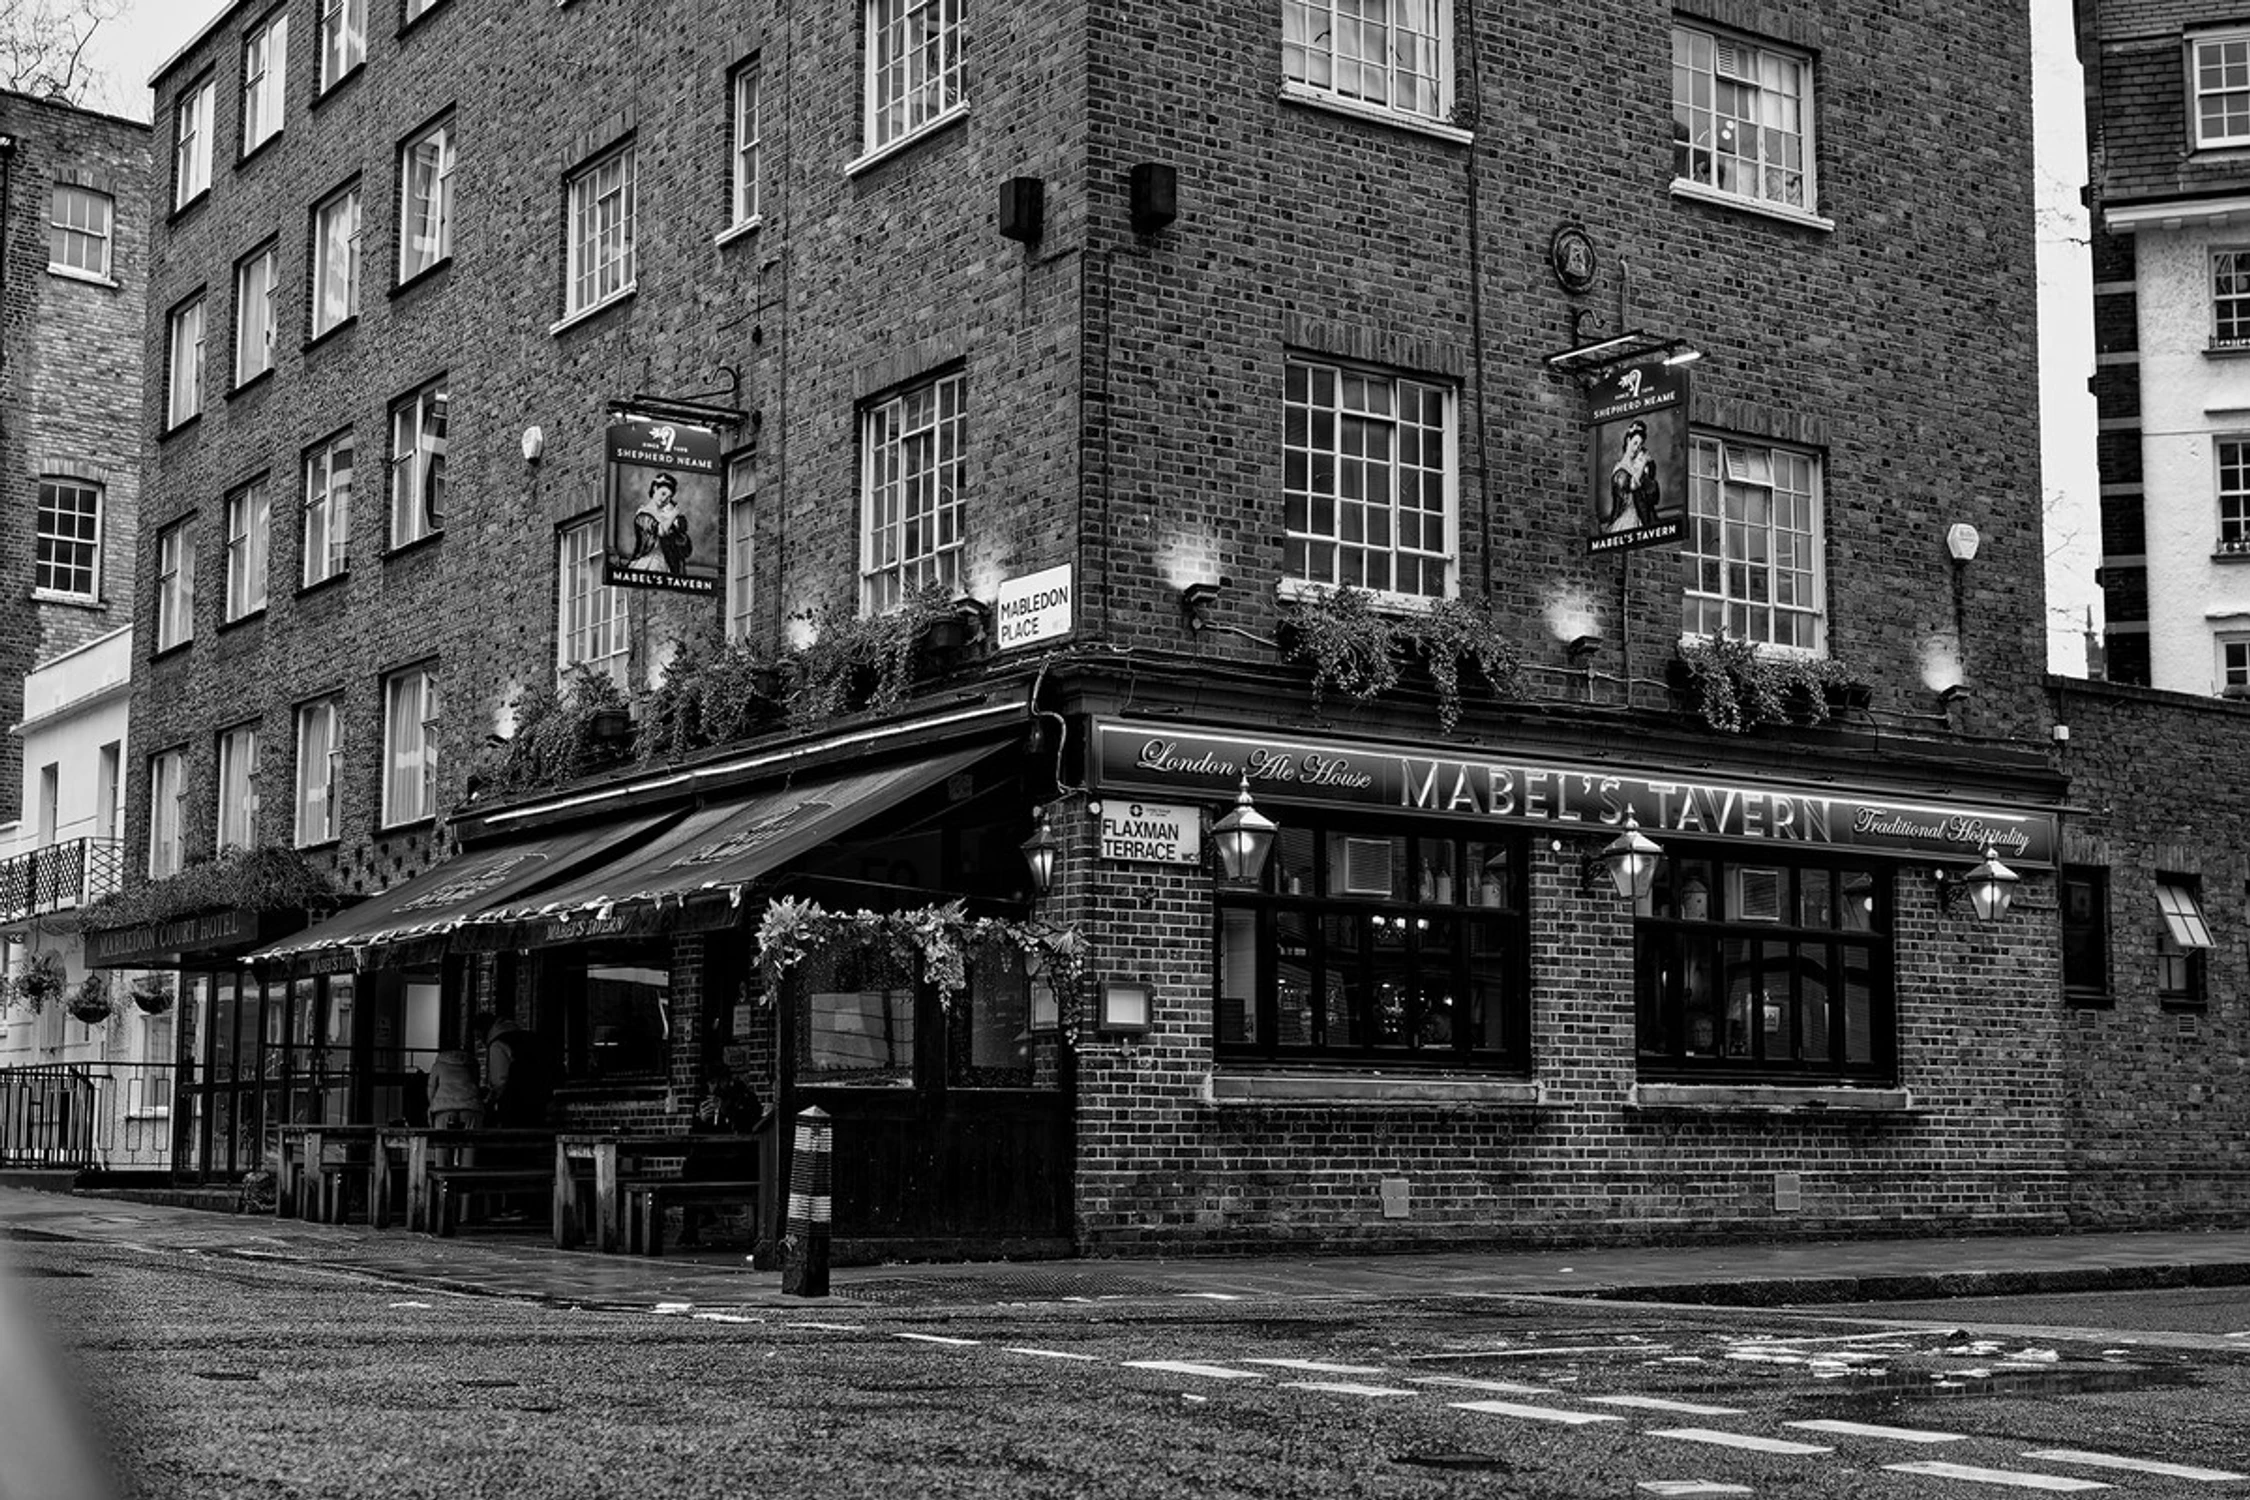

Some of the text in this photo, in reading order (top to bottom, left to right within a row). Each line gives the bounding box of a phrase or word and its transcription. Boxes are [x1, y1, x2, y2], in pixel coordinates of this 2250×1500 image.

[1593, 399, 1642, 420] SHEPHERD
[1644, 390, 1676, 407] NEAME
[617, 447, 674, 465] SHEPHERD
[677, 456, 713, 470] NEAME
[1591, 524, 1676, 551] MABEL'S TAVERN
[612, 571, 713, 591] MABEL'S TAVERN
[1001, 585, 1068, 620] MABLEDON
[1002, 617, 1039, 642] PLACE
[1136, 738, 1373, 789] London Ale House
[1401, 759, 1832, 844] MABEL'S TAVERN
[1103, 819, 1179, 841] FLAXMAN
[1853, 806, 2032, 857] Traditional Hospitality
[1104, 839, 1176, 861] TERRACE
[98, 911, 240, 957] MABLEDON COURT HOTEL
